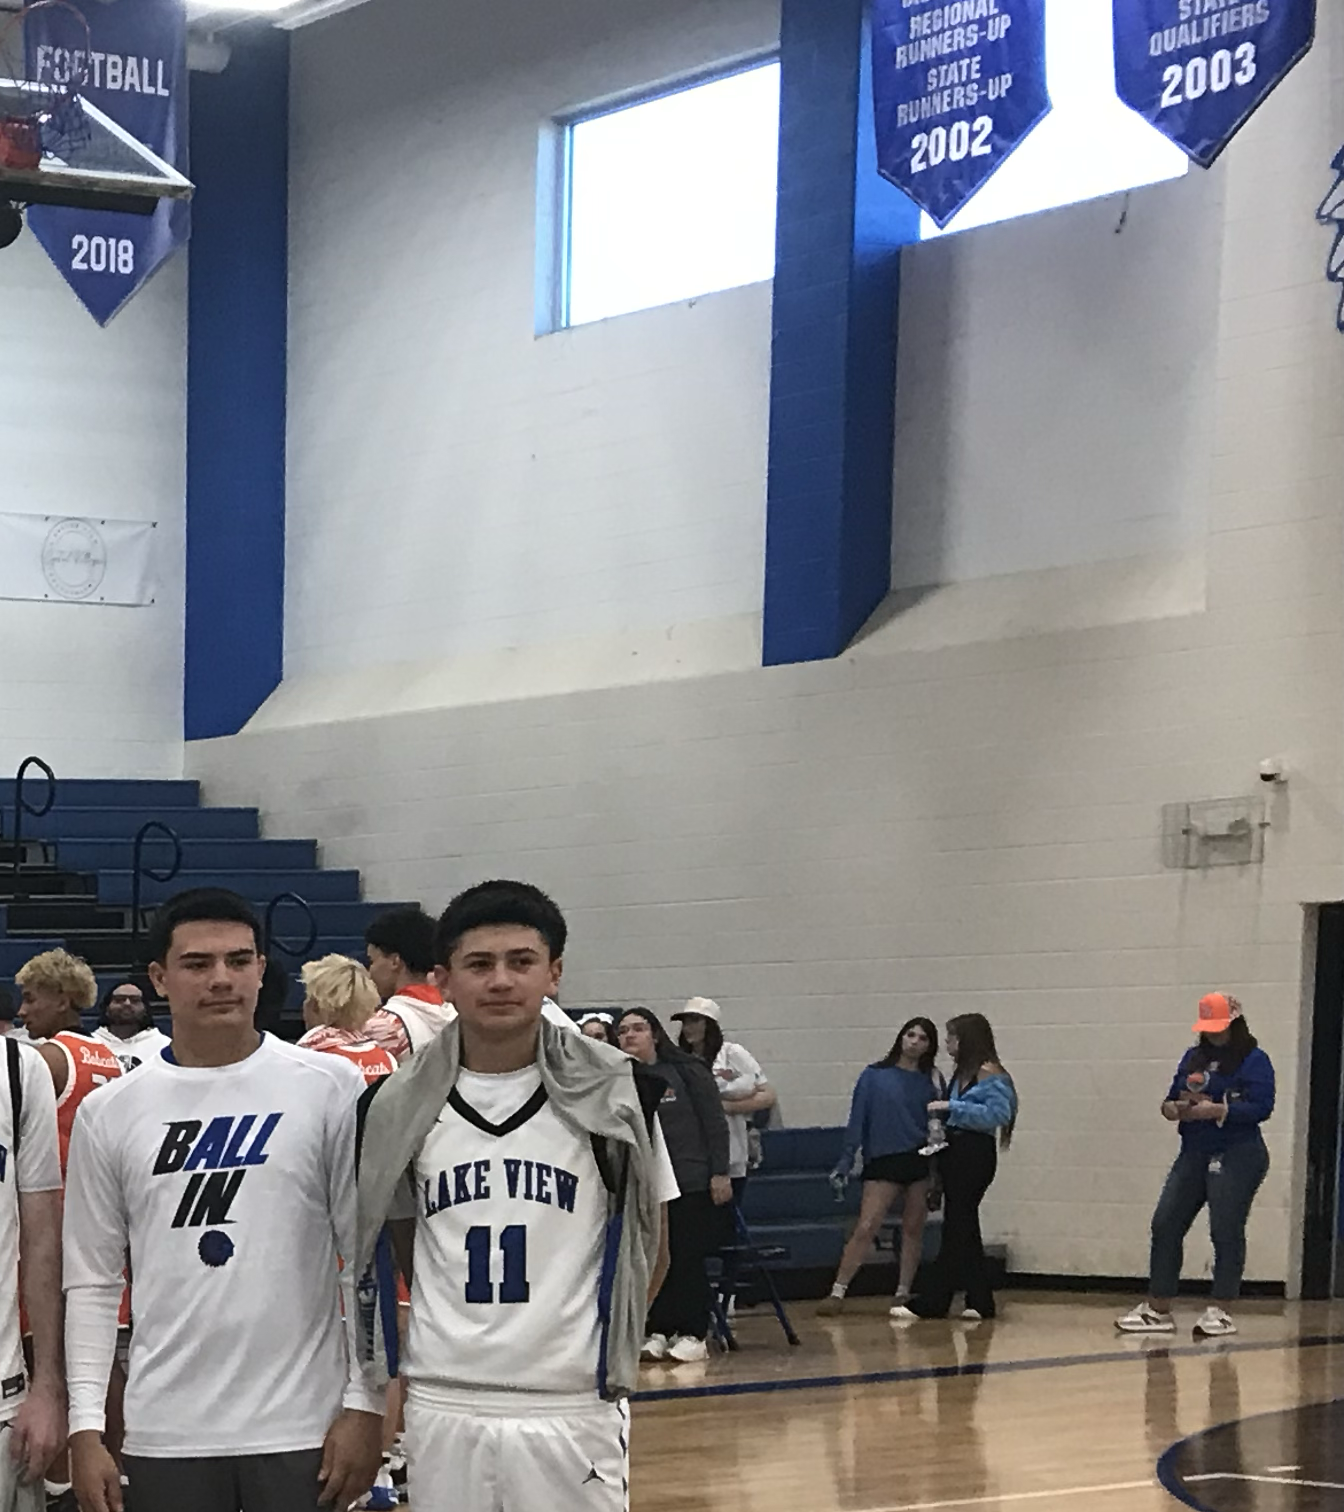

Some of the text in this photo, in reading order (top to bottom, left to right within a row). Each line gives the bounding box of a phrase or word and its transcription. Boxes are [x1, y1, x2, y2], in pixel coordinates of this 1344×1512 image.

[909, 0, 1000, 39] REGIONAL
[1149, 1, 1270, 57] QUALIFIERS
[1179, 0, 1240, 21] STA
[896, 14, 1012, 69] RUNNERS-UP
[897, 73, 1013, 128] RUNNERS-UP
[927, 55, 982, 92] STATE
[1161, 42, 1257, 109] 2003
[910, 114, 994, 174] 2002
[71, 234, 135, 275] 2018
[152, 1111, 284, 1176] BALL
[170, 1168, 247, 1229] IN
[423, 1157, 579, 1219] LAKE VIEW
[464, 1223, 530, 1304] 11
